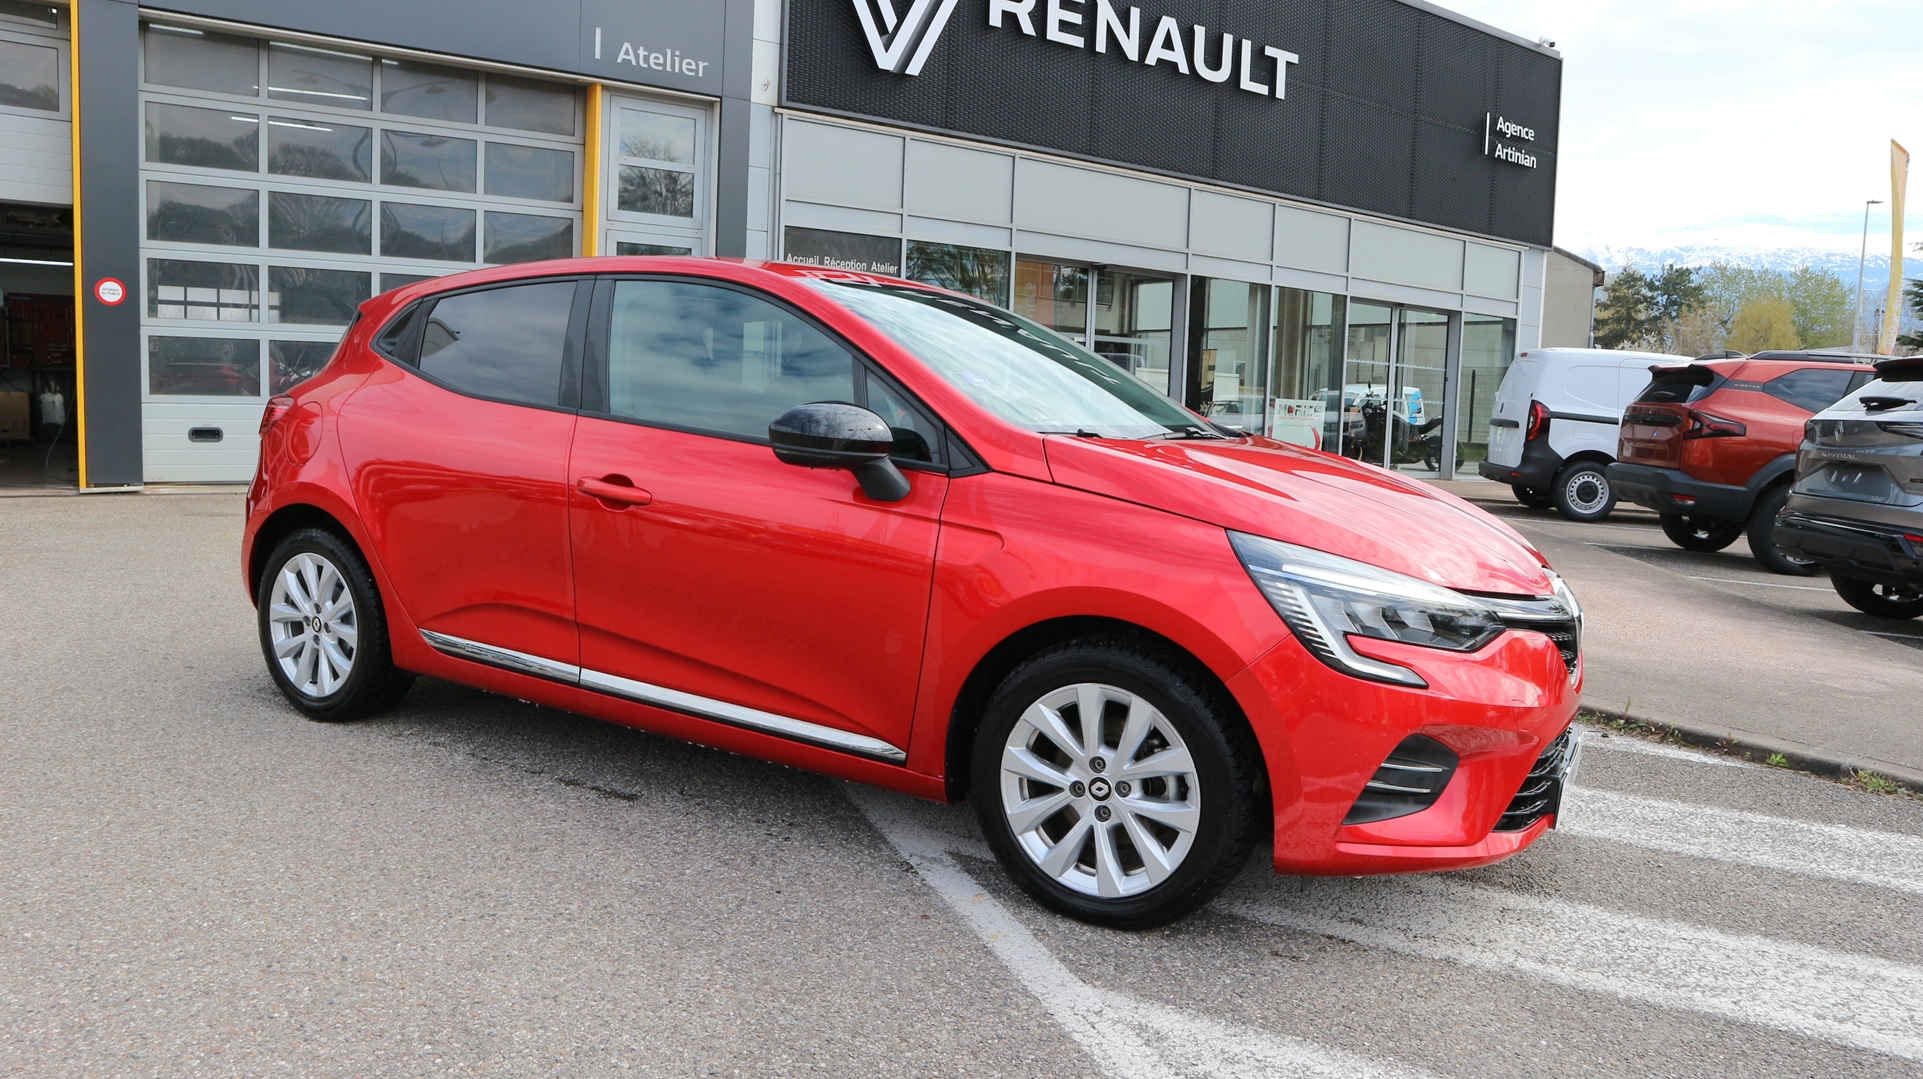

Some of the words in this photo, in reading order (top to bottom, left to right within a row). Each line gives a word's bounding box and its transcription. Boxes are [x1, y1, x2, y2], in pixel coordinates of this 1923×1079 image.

[616, 41, 708, 77] Atelier
[1496, 116, 1535, 141] Agence
[1494, 143, 1537, 169] Artinian
[786, 253, 820, 265] Accueil
[824, 256, 867, 271] Réception
[870, 261, 898, 274] Atelier
[1820, 451, 1859, 460] AUSTRAL
